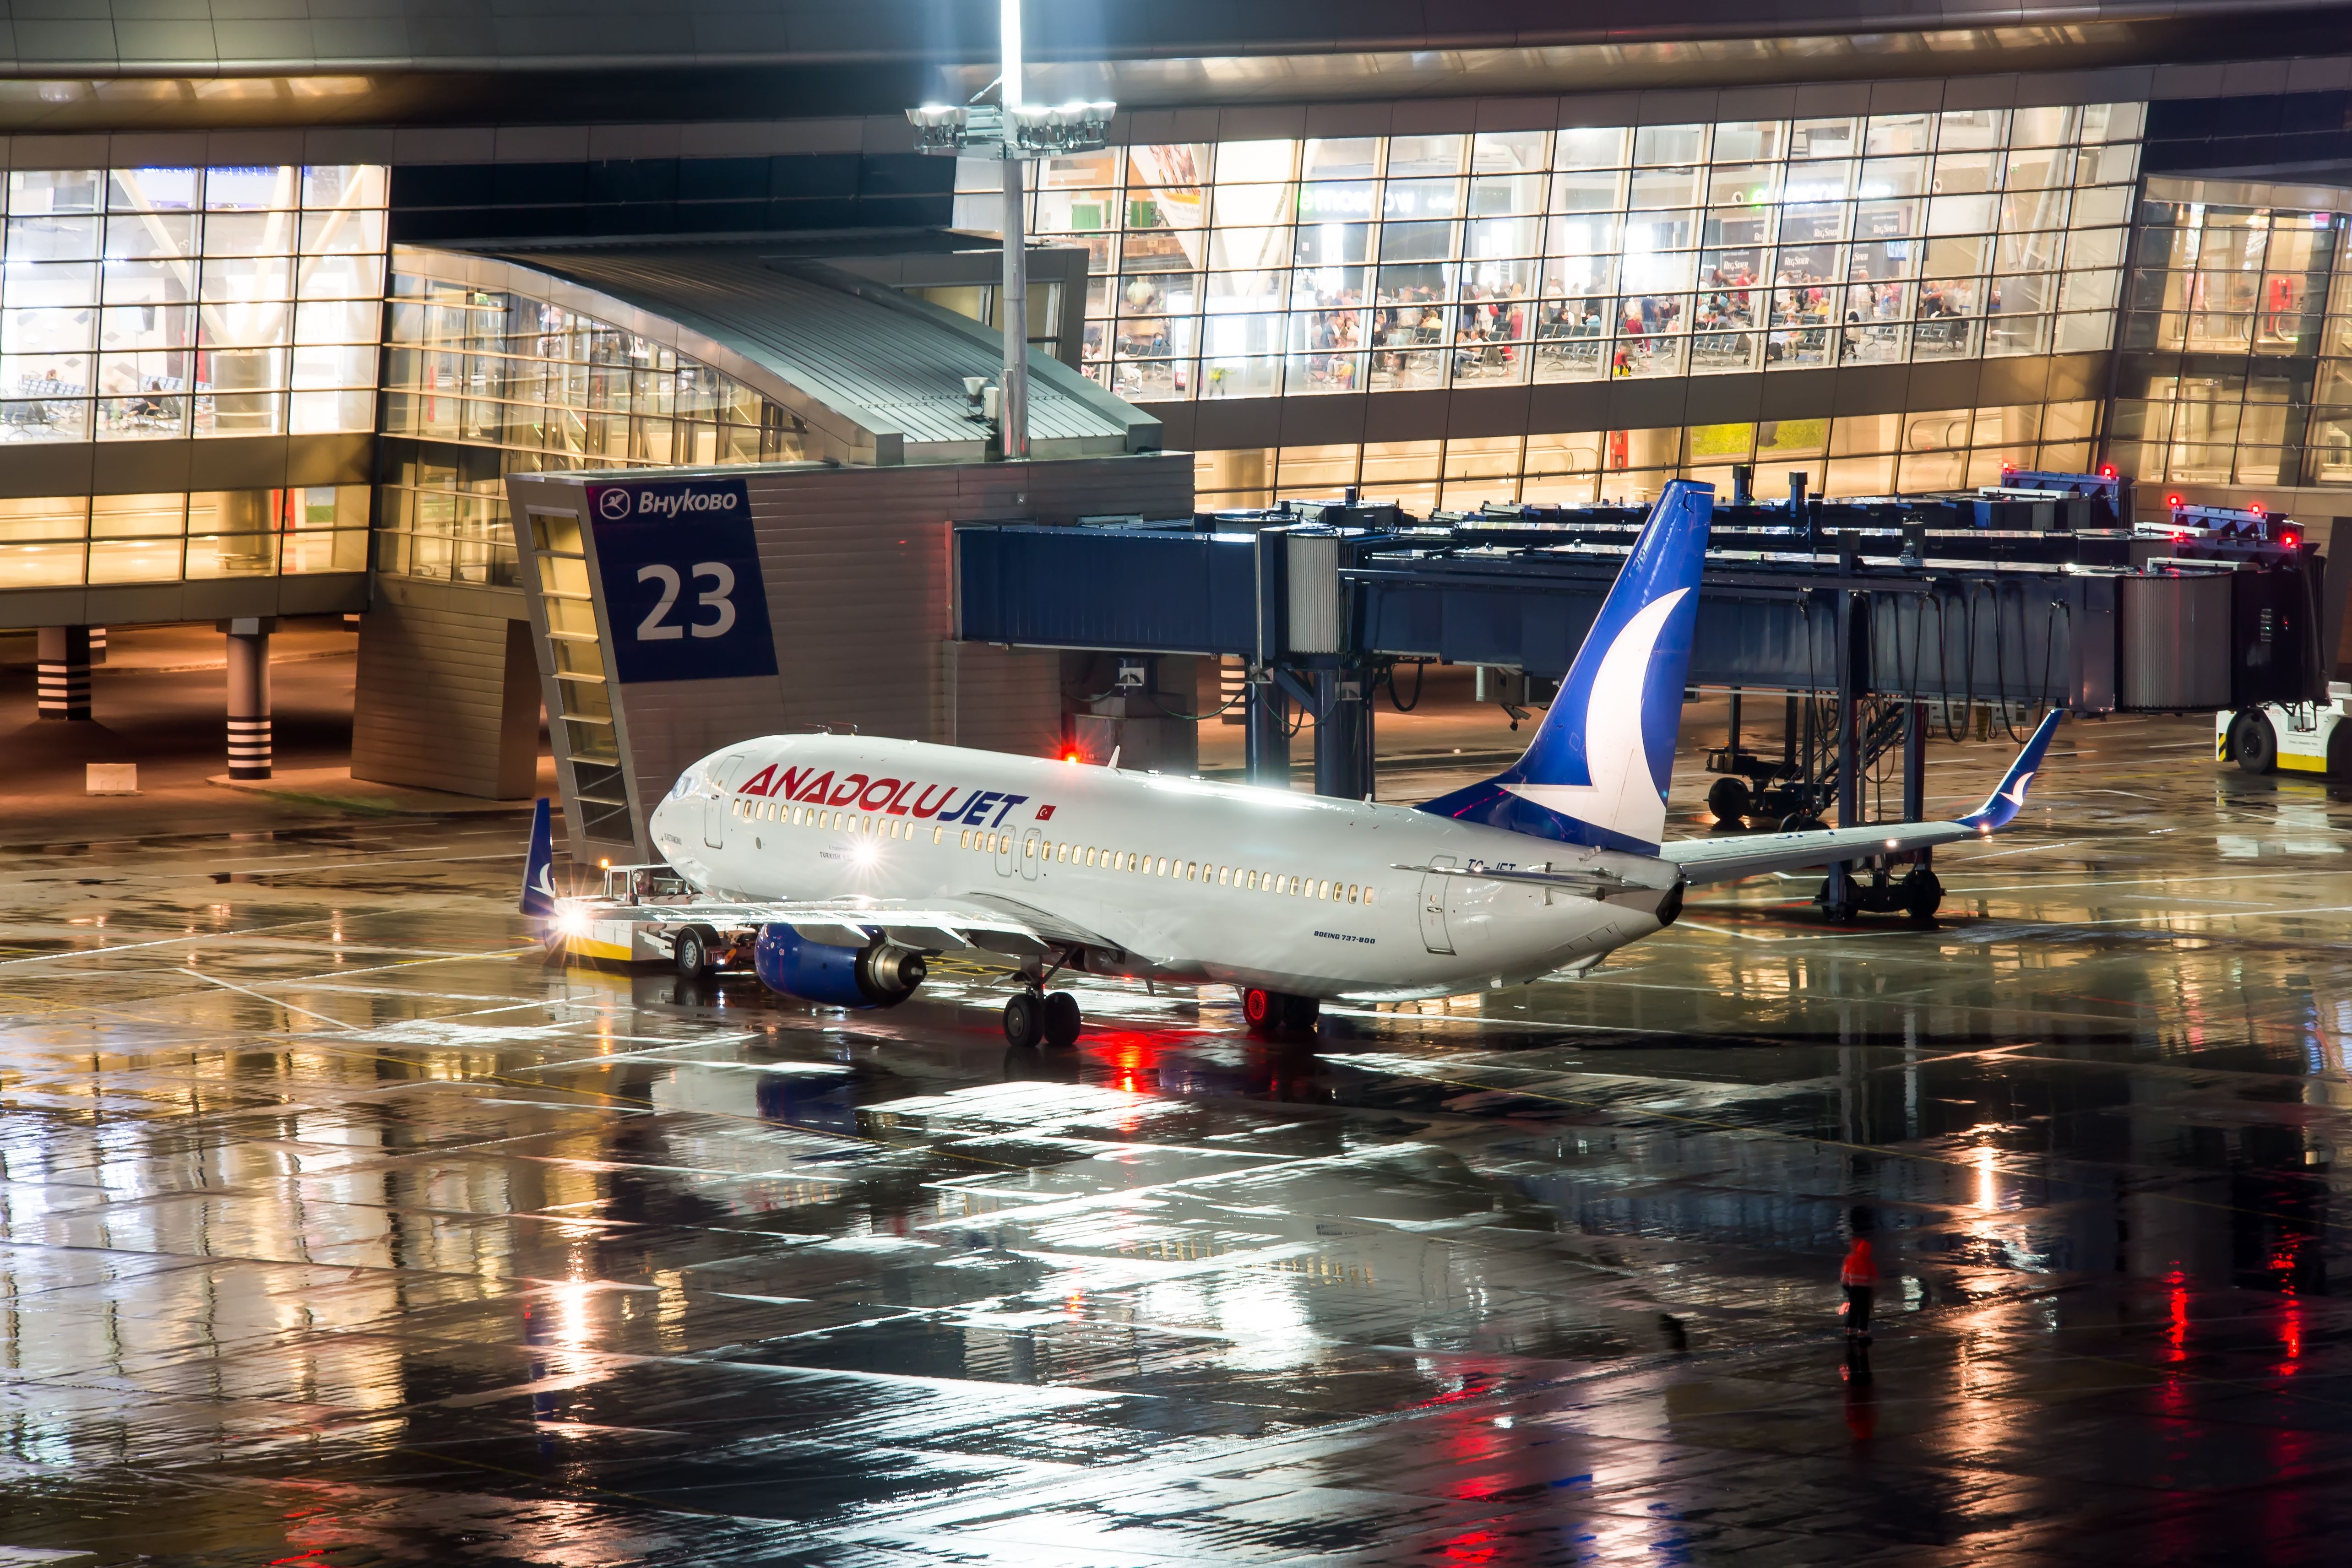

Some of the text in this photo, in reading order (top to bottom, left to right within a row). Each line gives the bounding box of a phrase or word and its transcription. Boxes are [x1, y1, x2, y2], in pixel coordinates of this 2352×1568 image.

[638, 488, 738, 518] Внуково
[637, 562, 736, 640] 23
[737, 763, 1030, 828] ANADOLUJET
[1314, 930, 1376, 944] BOEING 737-800
